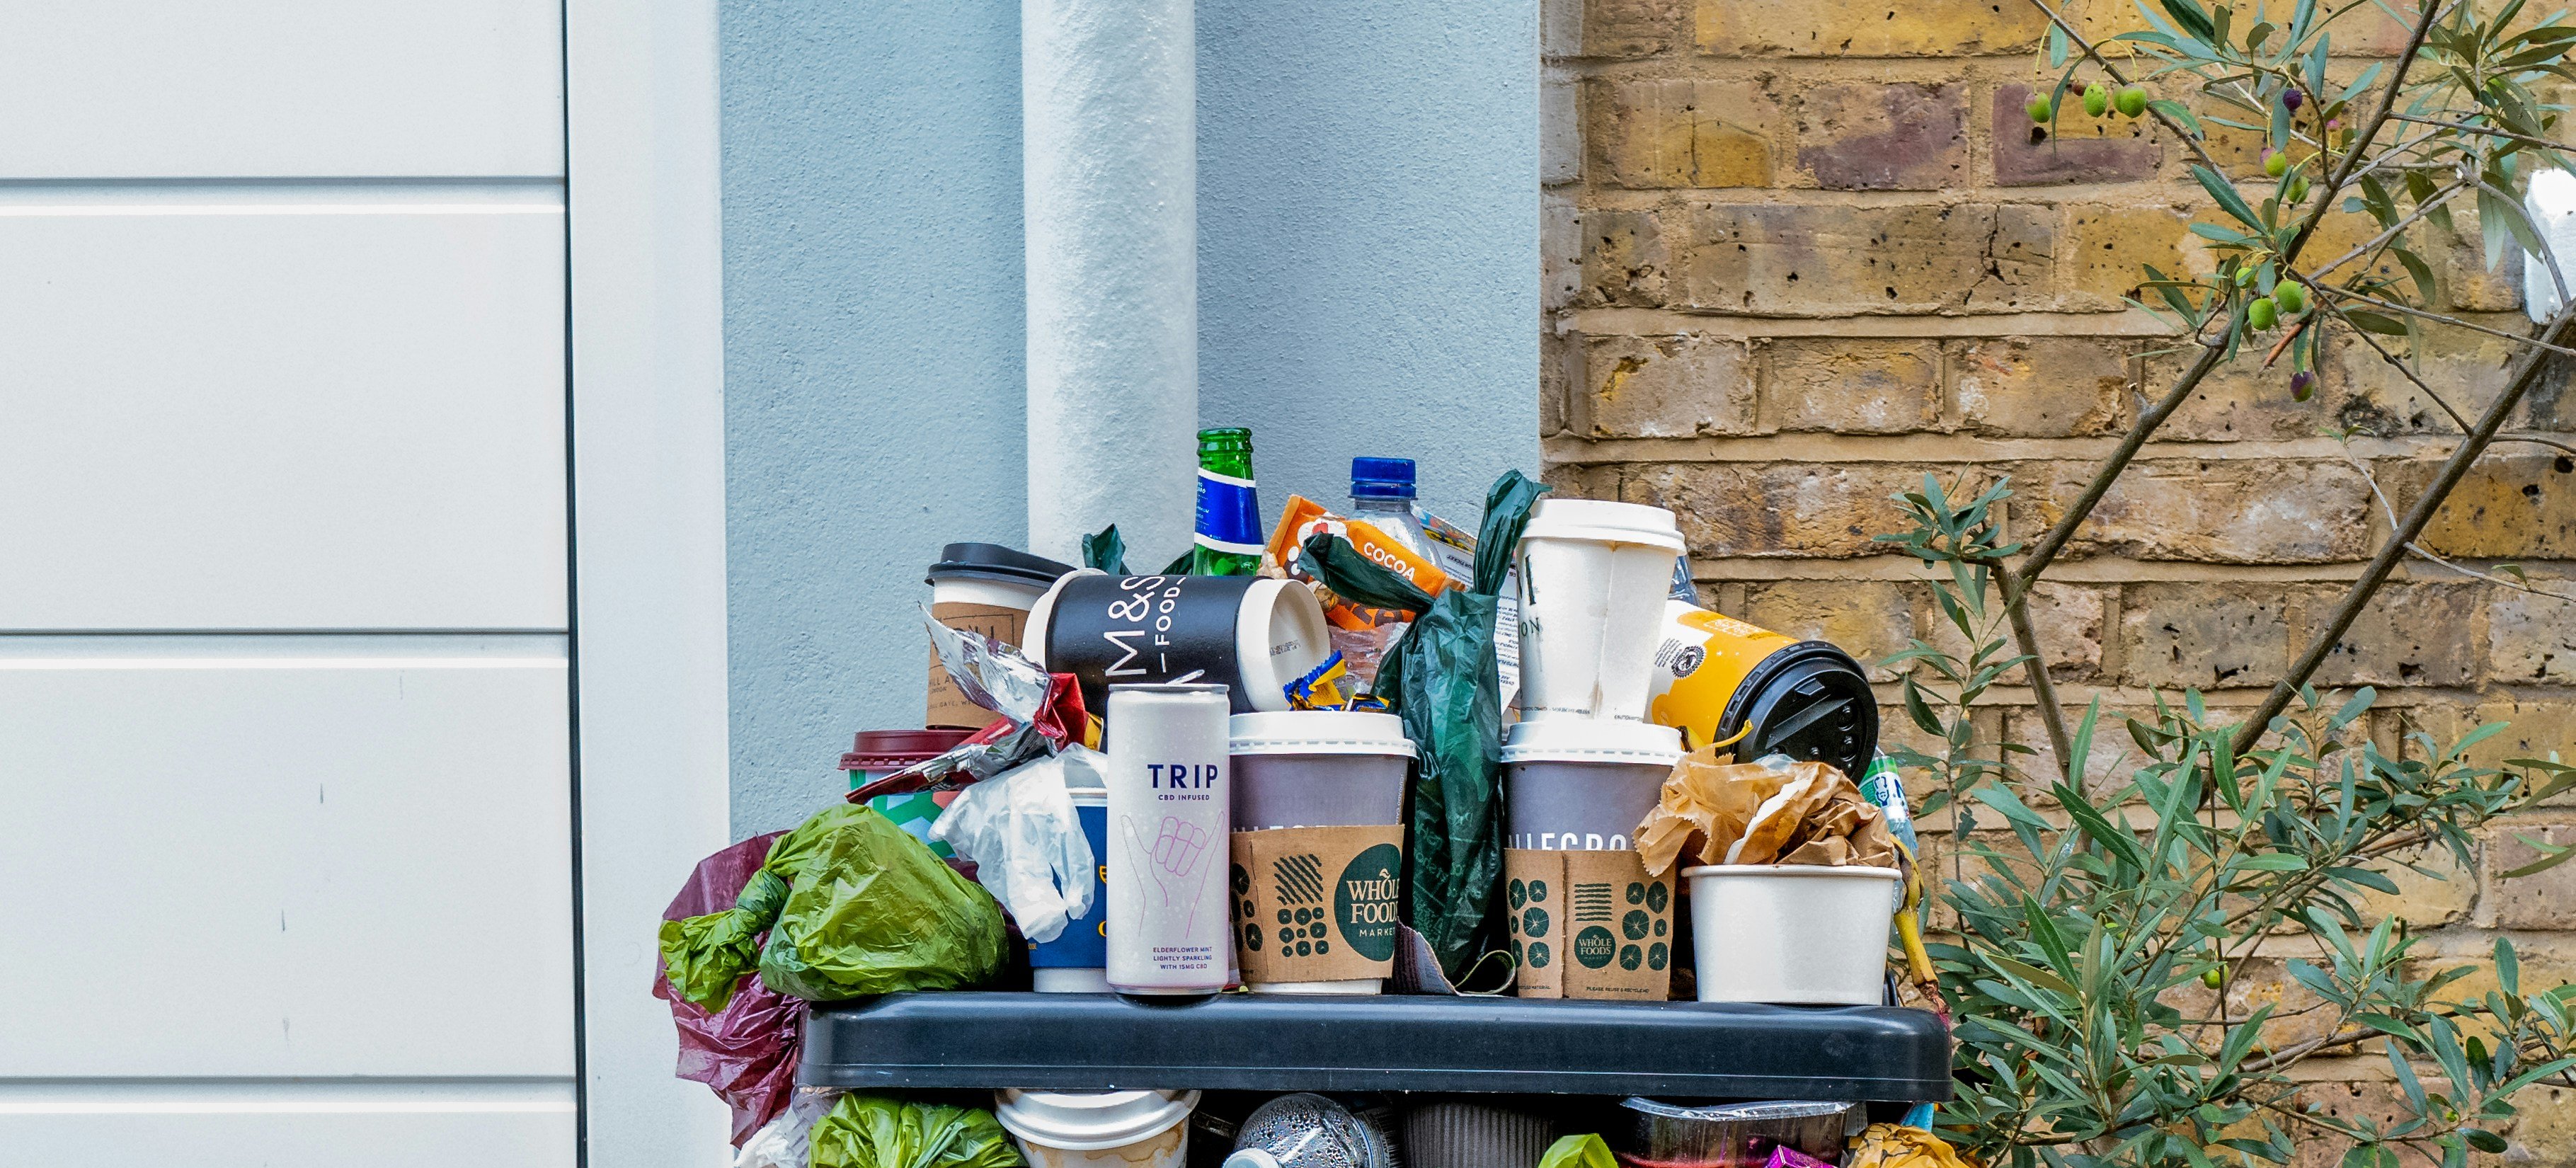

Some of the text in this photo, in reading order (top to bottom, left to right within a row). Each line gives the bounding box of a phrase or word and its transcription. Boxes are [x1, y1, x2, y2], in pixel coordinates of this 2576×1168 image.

[1363, 542, 1415, 582] COCOA
[1103, 576, 1166, 677] M&S
[1147, 764, 1218, 789] TRIP
[1579, 934, 1613, 947] WHOLE
[1580, 946, 1611, 955] FOODS
